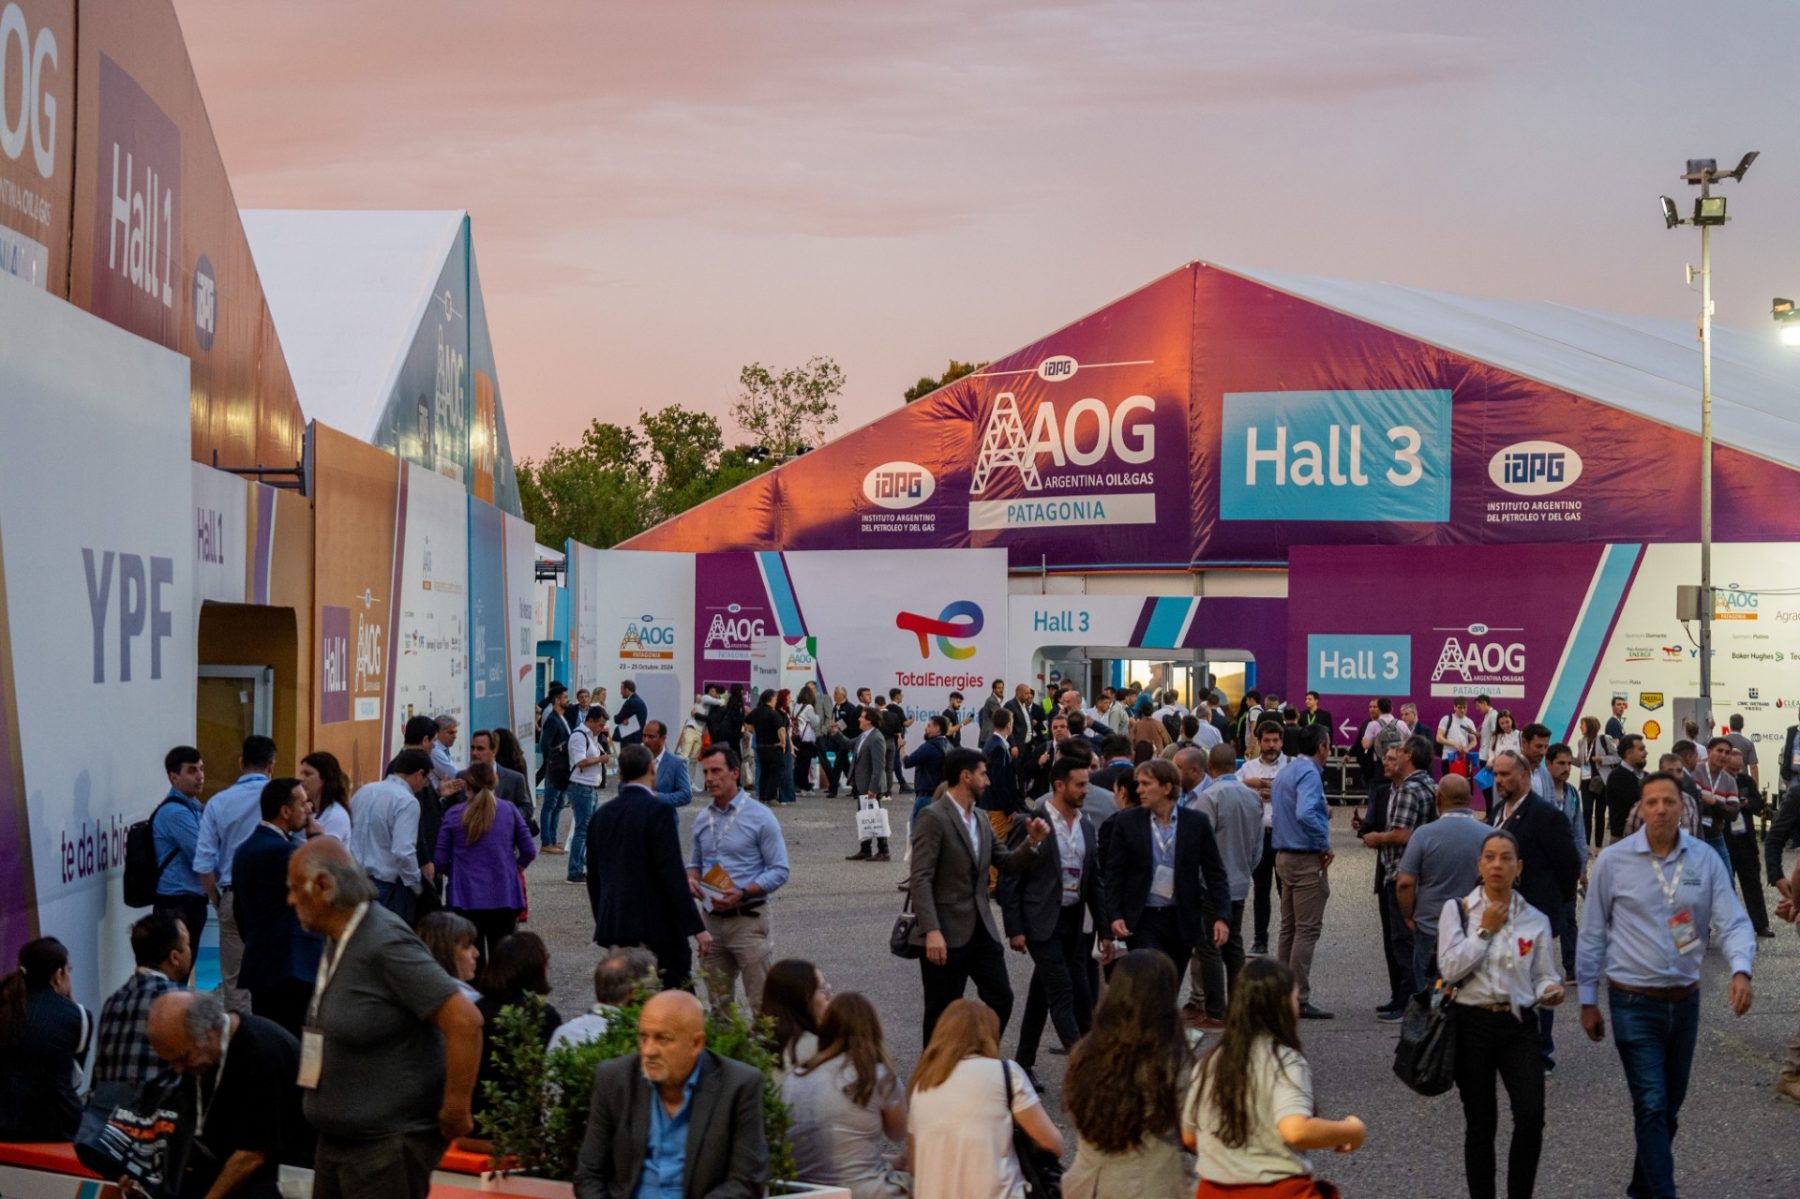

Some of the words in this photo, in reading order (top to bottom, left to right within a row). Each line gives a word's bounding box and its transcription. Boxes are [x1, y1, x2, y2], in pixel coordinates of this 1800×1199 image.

[109, 142, 158, 298] Hall
[163, 187, 172, 308] 1
[1245, 424, 1368, 486] Hall
[1386, 425, 1424, 487] 3
[1044, 474, 1104, 489] ARGENTINA
[1106, 472, 1154, 487] OIL&GAS
[1007, 500, 1105, 523] PATAGONIA
[1487, 502, 1530, 511] INSTITUTO
[1531, 501, 1582, 510] ARGENTINO
[1487, 513, 1500, 522] DEL
[1502, 512, 1539, 522] PETROLEO
[1540, 512, 1546, 521] Y
[1548, 512, 1564, 521] DEL
[1564, 512, 1581, 521] GAS
[861, 514, 895, 522] INSTITUTO
[896, 513, 936, 522] ARGENTINO
[861, 524, 873, 532] DEL
[873, 524, 903, 532] PETROLEO
[903, 524, 909, 532] Y
[909, 524, 921, 532] DEL
[921, 523, 936, 532] GAS
[197, 506, 216, 563] Hall
[218, 511, 224, 565] 1
[81, 547, 174, 683] YPF
[1034, 610, 1073, 632] Hall
[1078, 611, 1090, 632] 3
[324, 637, 341, 692] Hall
[342, 638, 347, 691] 1
[1319, 650, 1376, 680] Hall
[1382, 650, 1399, 680] 3
[1731, 651, 1750, 659] Baker
[1751, 651, 1774, 662] Hughes
[896, 672, 984, 691] TotalEnergies
[1453, 686, 1502, 695] PATAGONIA
[61, 830, 75, 884] te
[78, 822, 95, 879] da
[97, 818, 108, 872] la
